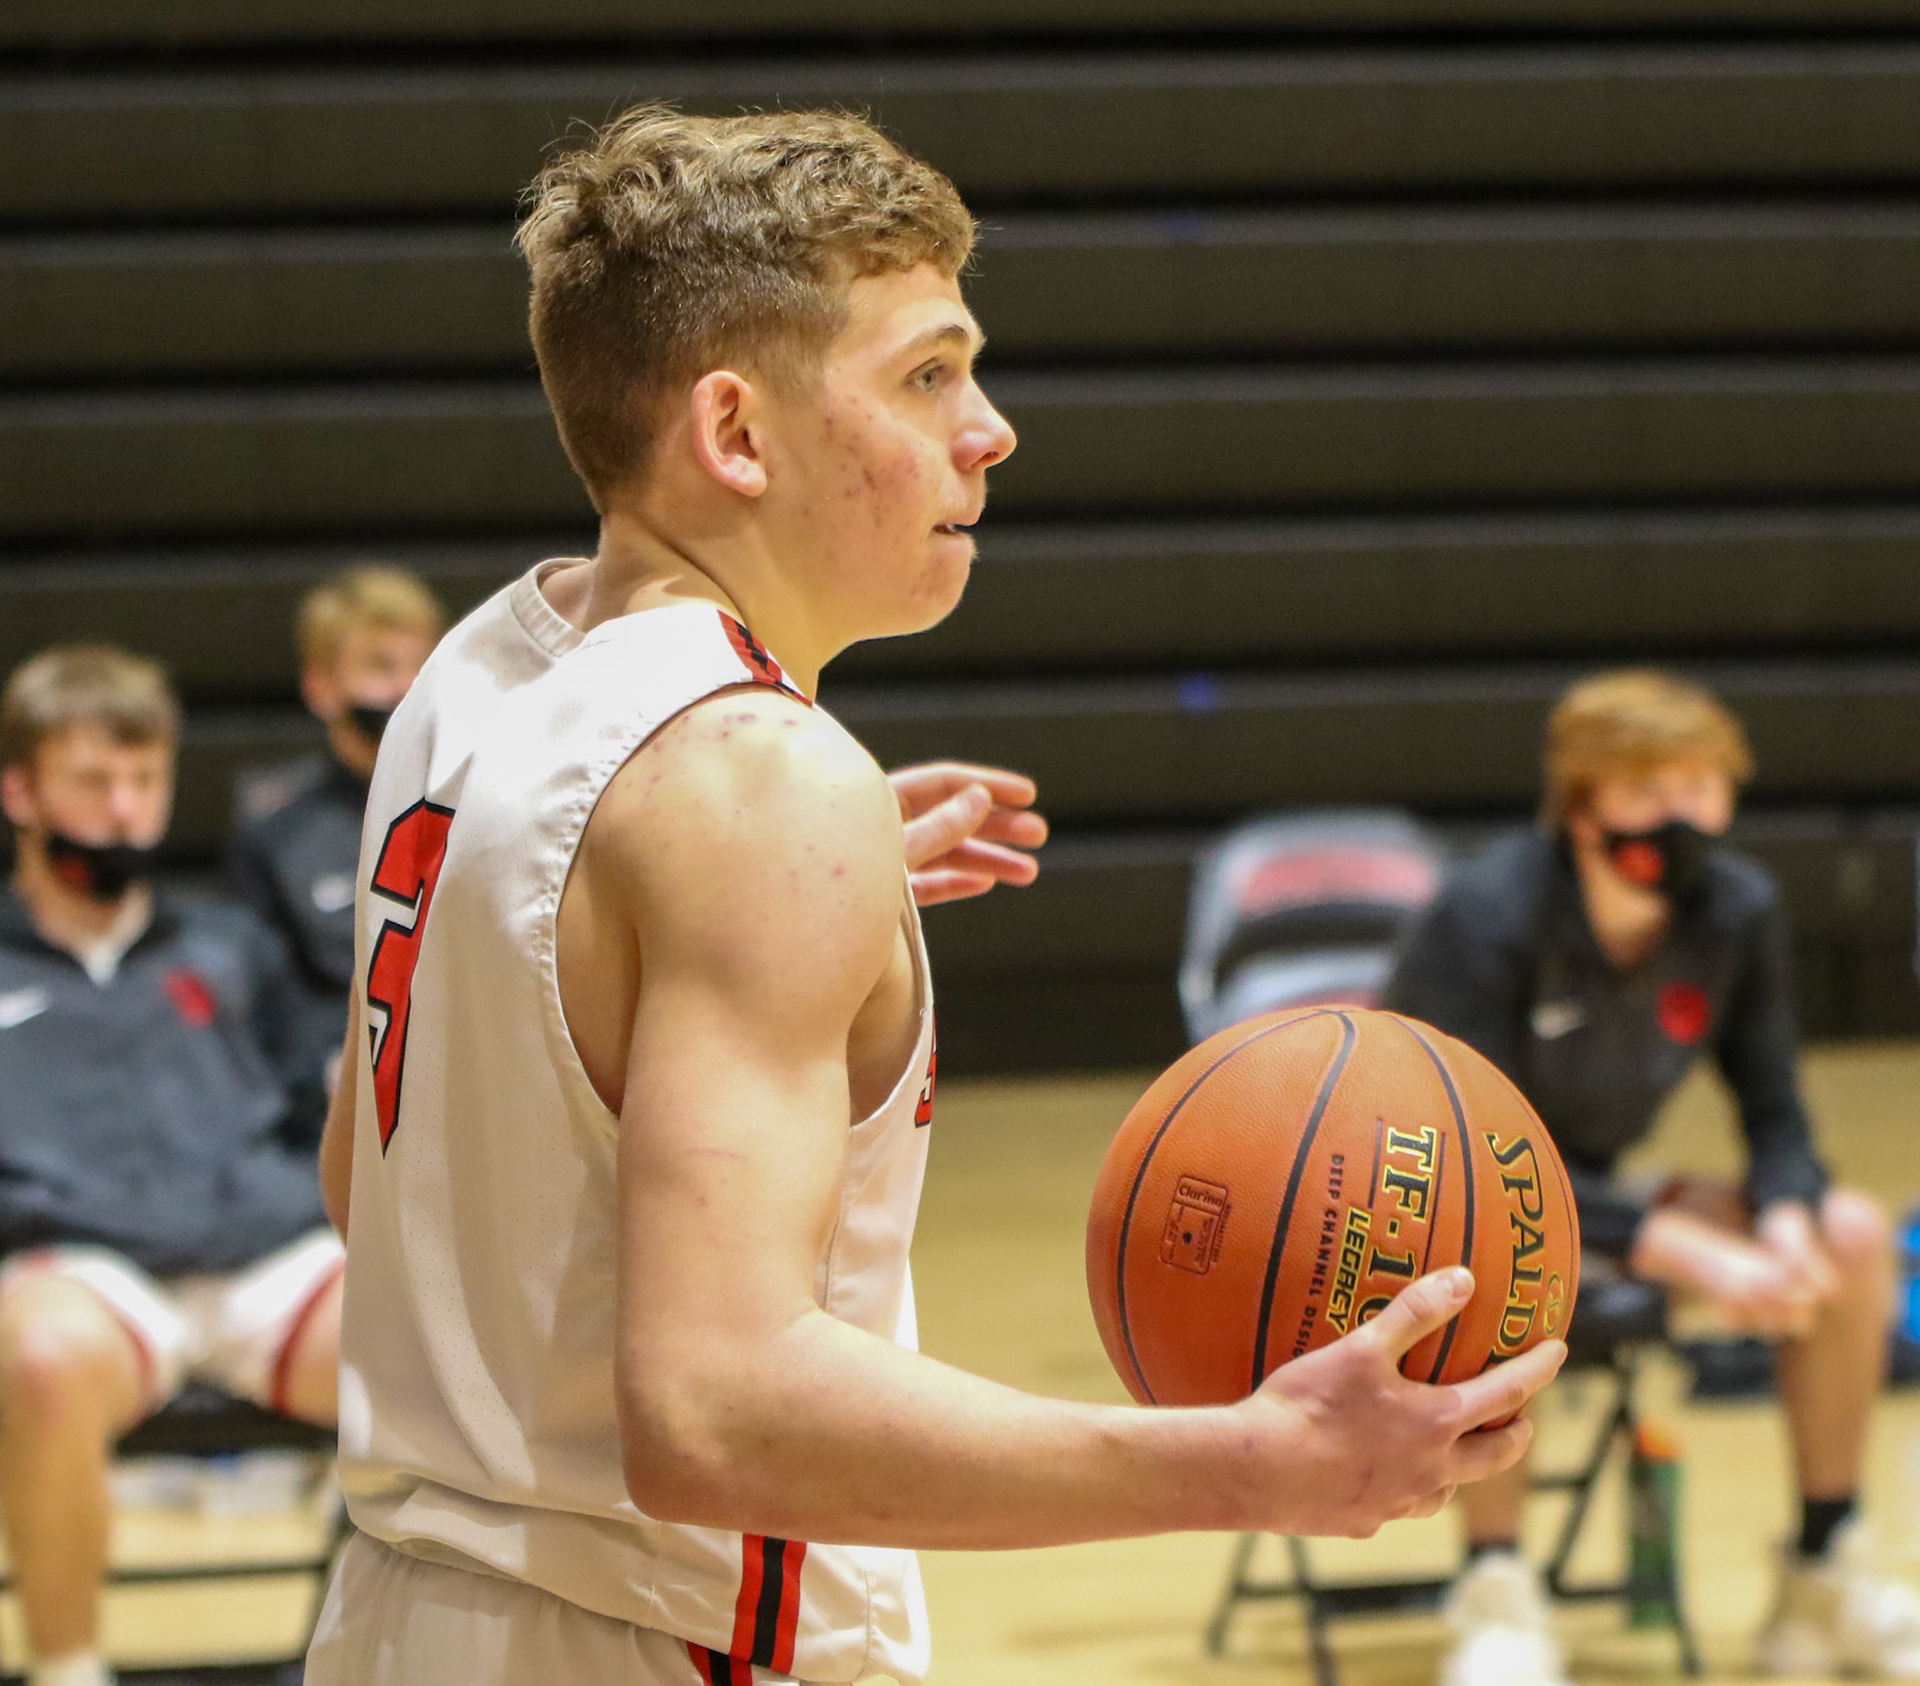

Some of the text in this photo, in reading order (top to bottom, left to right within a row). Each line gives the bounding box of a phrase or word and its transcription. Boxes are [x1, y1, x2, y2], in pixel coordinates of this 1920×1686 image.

[1178, 1185, 1223, 1207] Clarino
[1328, 1153, 1344, 1200] DEEP
[1309, 1209, 1337, 1297] CHANNEL
[1325, 1206, 1371, 1337] LEGACY
